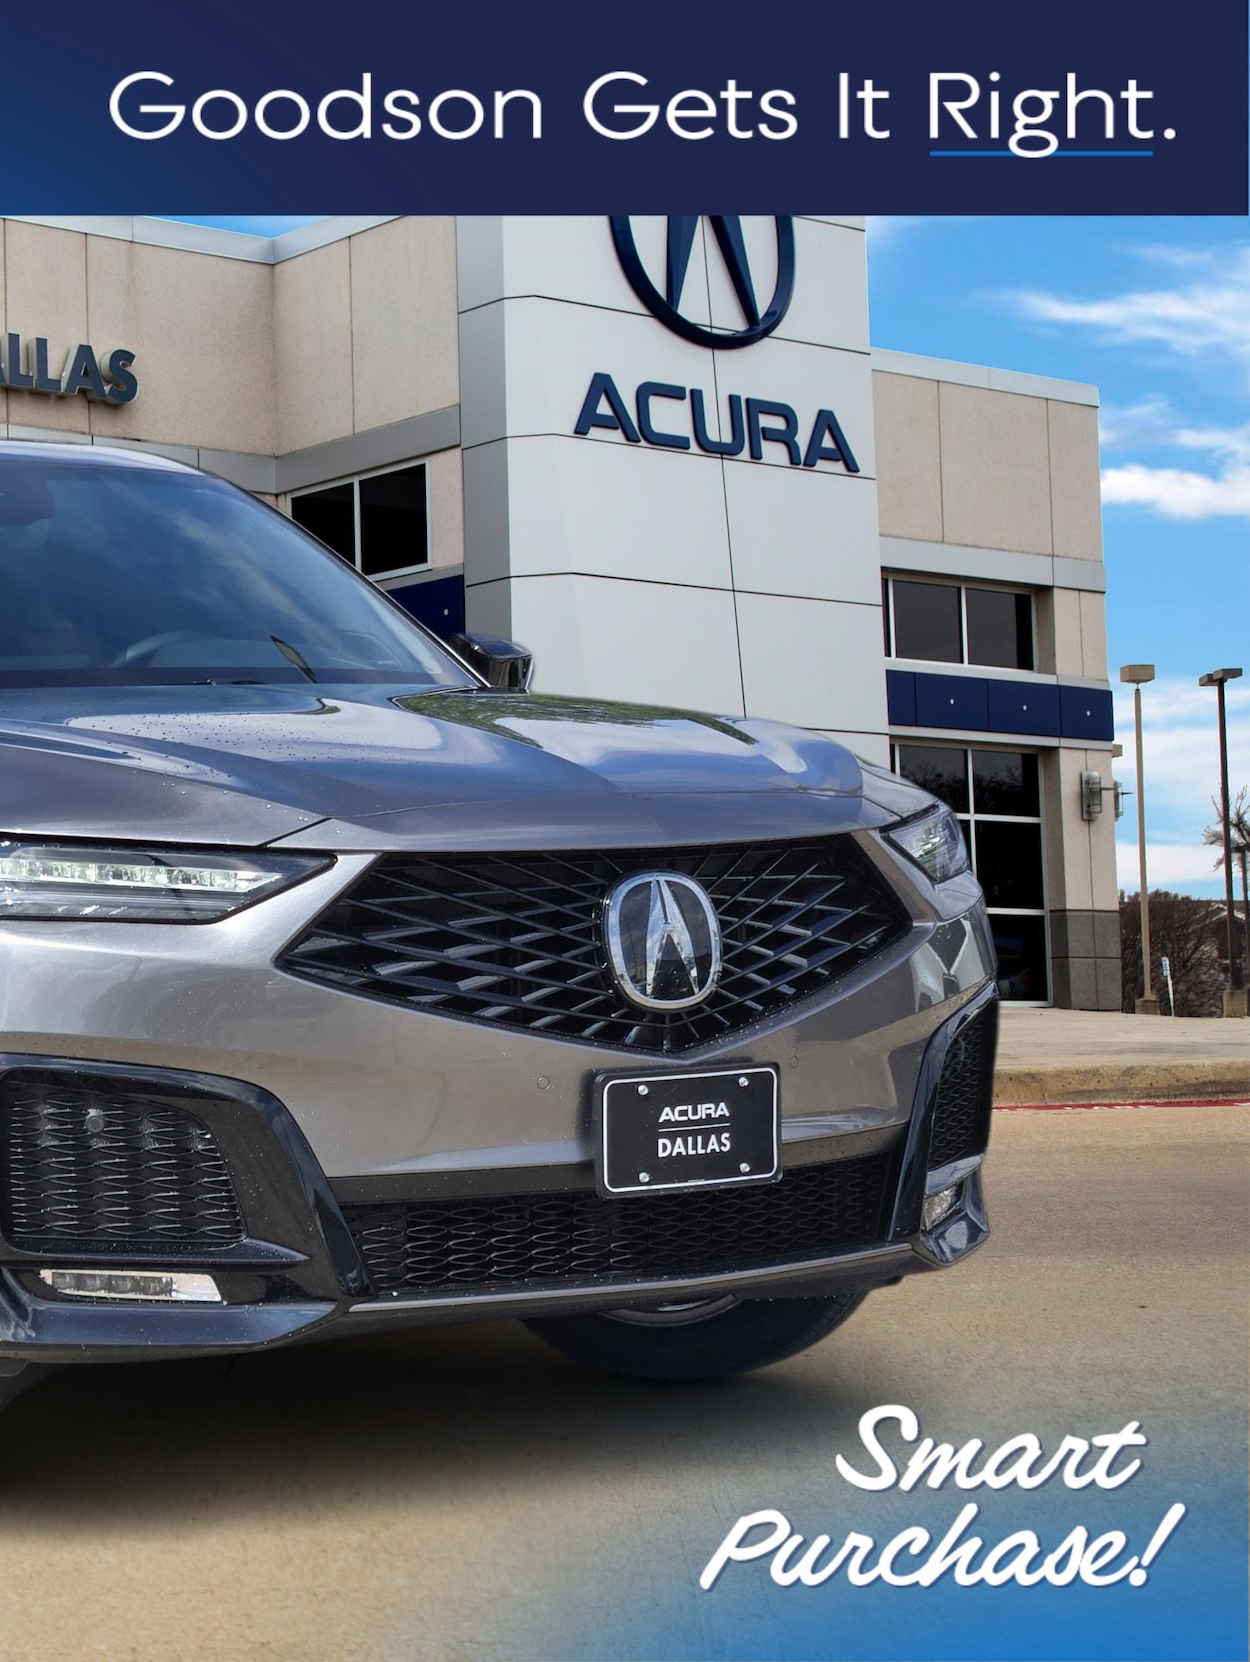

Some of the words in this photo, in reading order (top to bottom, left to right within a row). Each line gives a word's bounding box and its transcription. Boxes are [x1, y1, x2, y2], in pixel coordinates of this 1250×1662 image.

[573, 371, 860, 473] ACURA
[658, 1101, 730, 1123] ACURA
[657, 1131, 732, 1158] DALLAS
